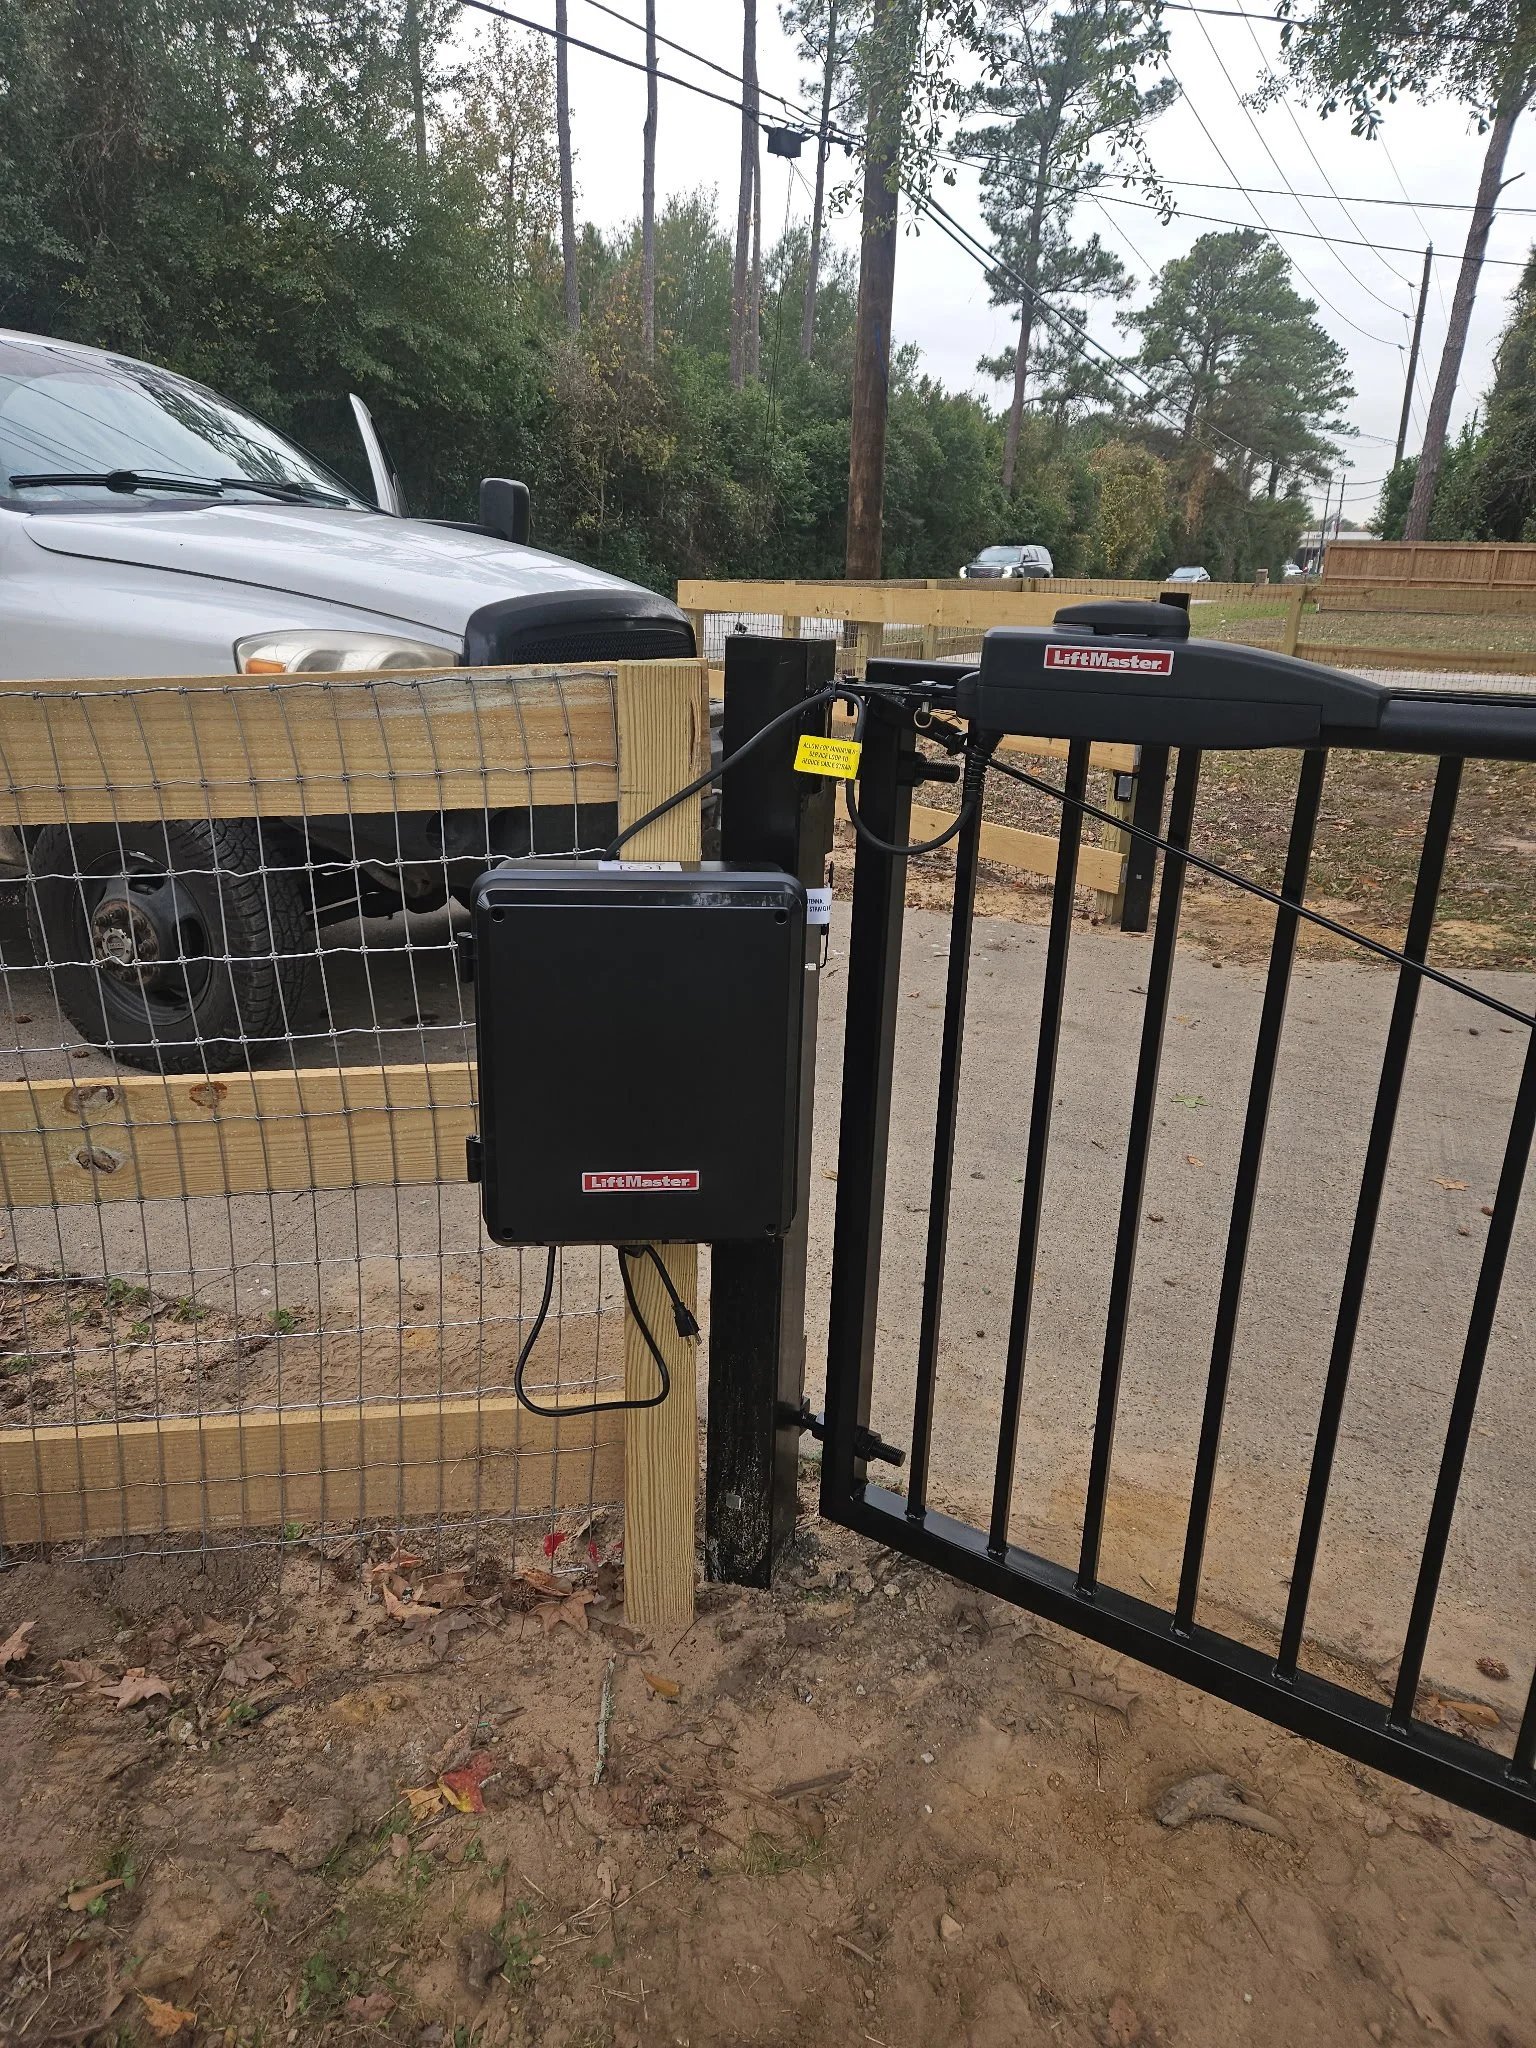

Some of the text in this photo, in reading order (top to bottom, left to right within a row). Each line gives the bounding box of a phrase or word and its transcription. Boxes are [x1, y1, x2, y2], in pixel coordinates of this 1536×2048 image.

[1053, 649, 1163, 670] LiftMaster
[803, 742, 819, 750] ALLOW
[809, 751, 828, 759] SERVICE
[802, 757, 852, 771] REDUCE CABLE STRAIN
[591, 1175, 691, 1188] LiftMaster
